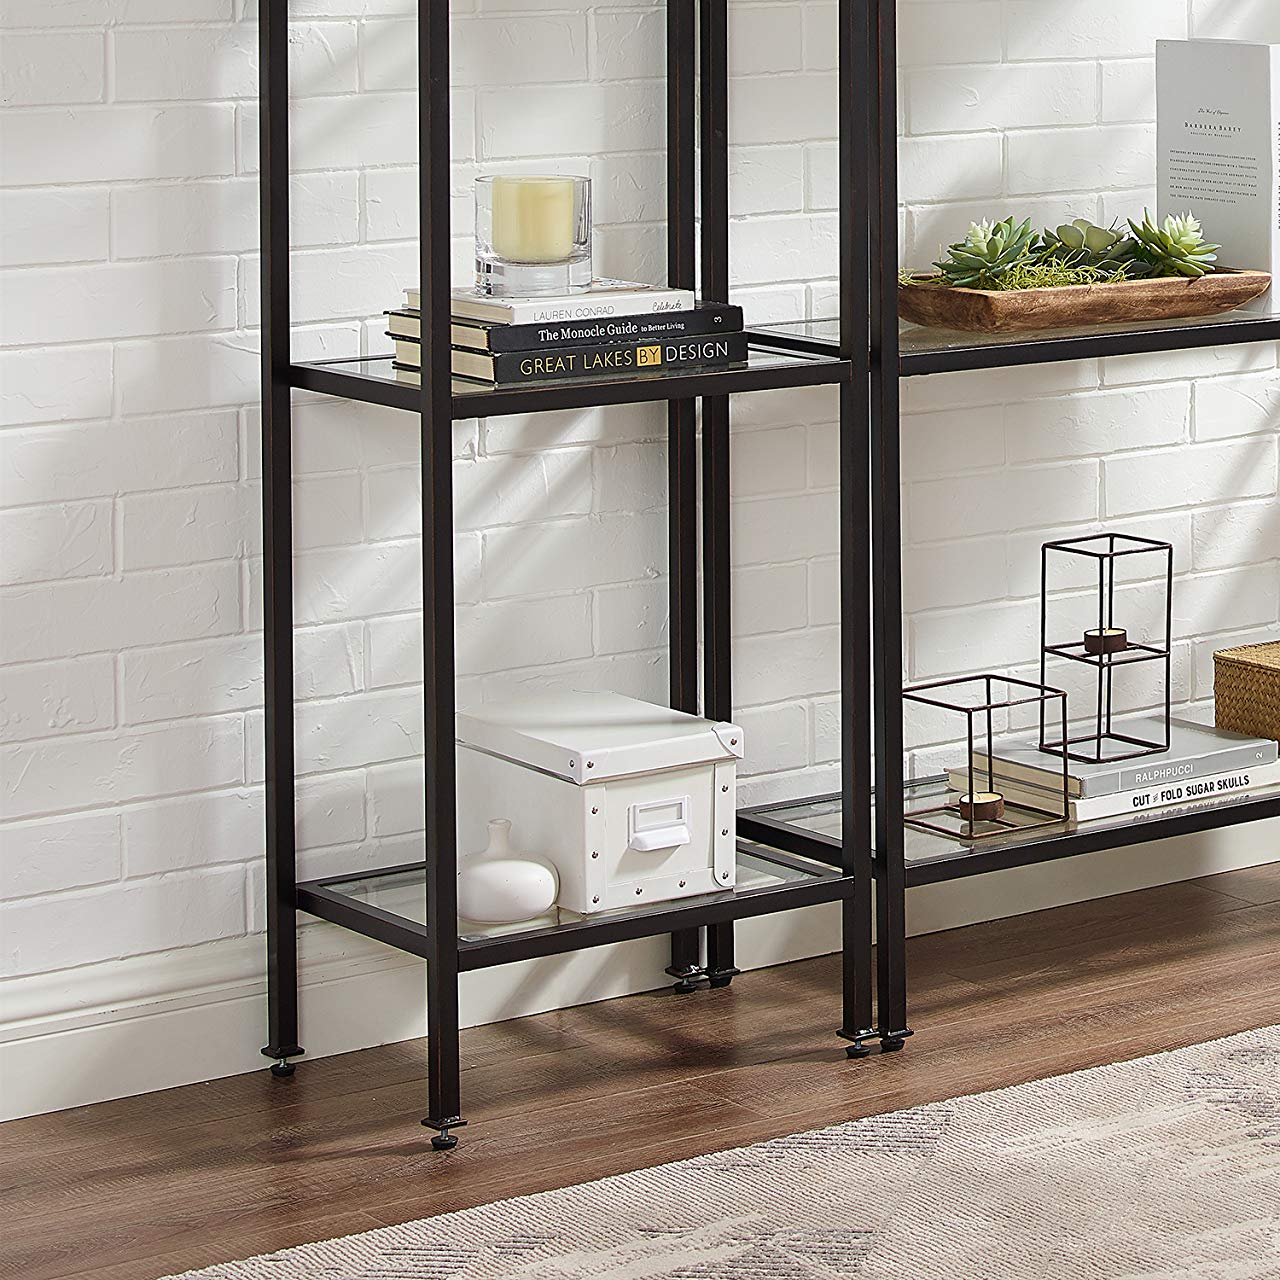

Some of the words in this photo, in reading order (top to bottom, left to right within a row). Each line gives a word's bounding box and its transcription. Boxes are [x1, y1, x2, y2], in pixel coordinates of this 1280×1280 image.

[533, 310, 572, 321] LAUREN
[575, 305, 615, 318] CONRAD
[538, 329, 559, 342] The
[560, 324, 606, 340] Monocle
[606, 322, 639, 336] Guide
[648, 324, 666, 332] Better
[666, 322, 685, 330] Living
[520, 354, 577, 375] GREAT
[583, 350, 633, 370] LAKES
[640, 347, 659, 364] BY
[665, 341, 728, 362] DESIGN
[1132, 794, 1151, 808] CUT
[1161, 788, 1183, 802] FOLD
[1186, 780, 1215, 797] SUGAR
[1217, 774, 1250, 792] SKULLS
